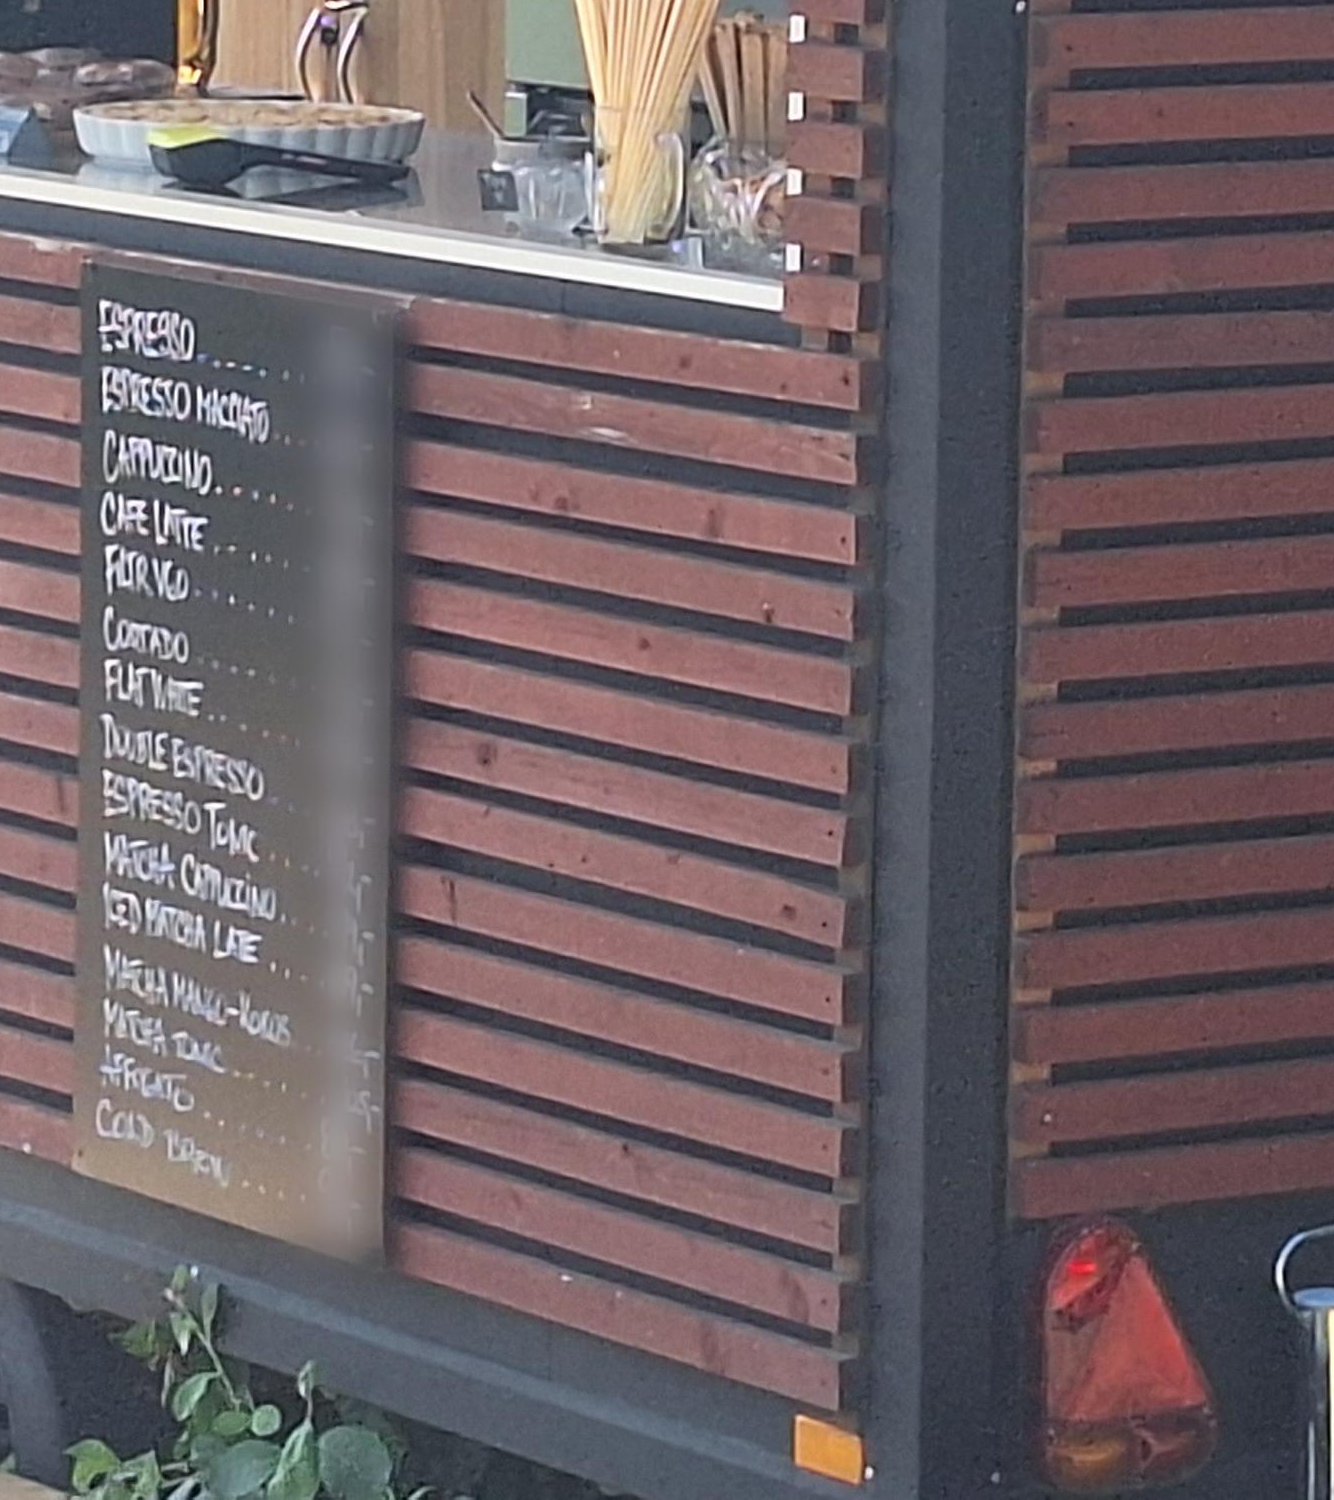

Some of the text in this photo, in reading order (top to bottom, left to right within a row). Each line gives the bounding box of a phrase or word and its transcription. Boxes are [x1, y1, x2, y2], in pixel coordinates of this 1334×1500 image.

[98, 299, 194, 361] ESPRESSO
[101, 366, 191, 421] ESPRESSO
[153, 498, 210, 553] LATTE
[103, 658, 153, 707] FLAT
[170, 736, 265, 800] ESPRESSO
[102, 768, 202, 834] ESPRESSO
[95, 1097, 155, 1150] COLD
